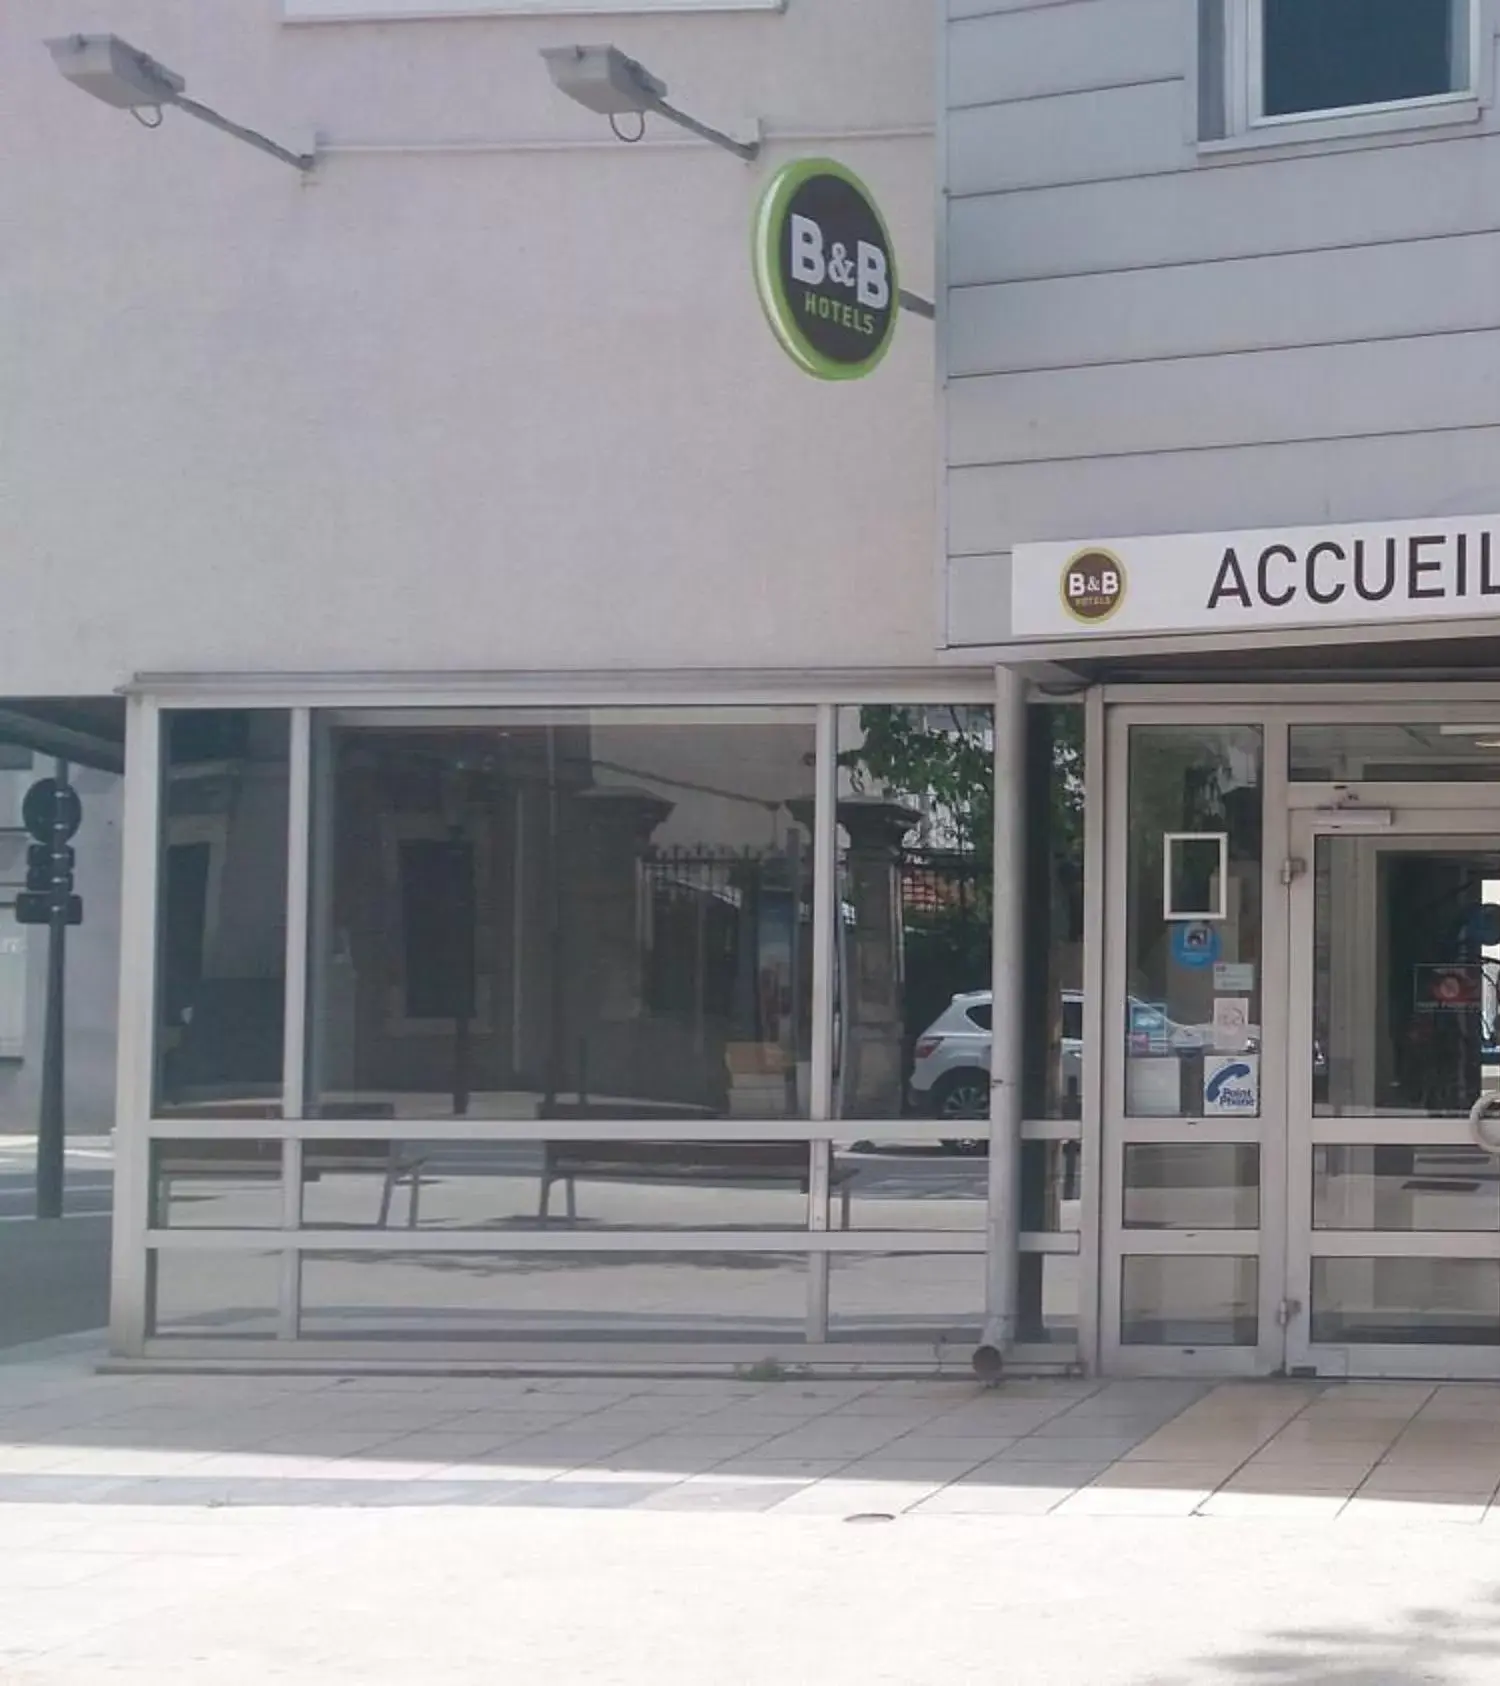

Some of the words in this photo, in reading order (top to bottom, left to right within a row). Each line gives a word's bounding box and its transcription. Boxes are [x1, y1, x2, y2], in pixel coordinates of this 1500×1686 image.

[791, 213, 889, 309] B&B
[804, 291, 876, 335] HOTELS
[1068, 571, 1120, 597] B&B
